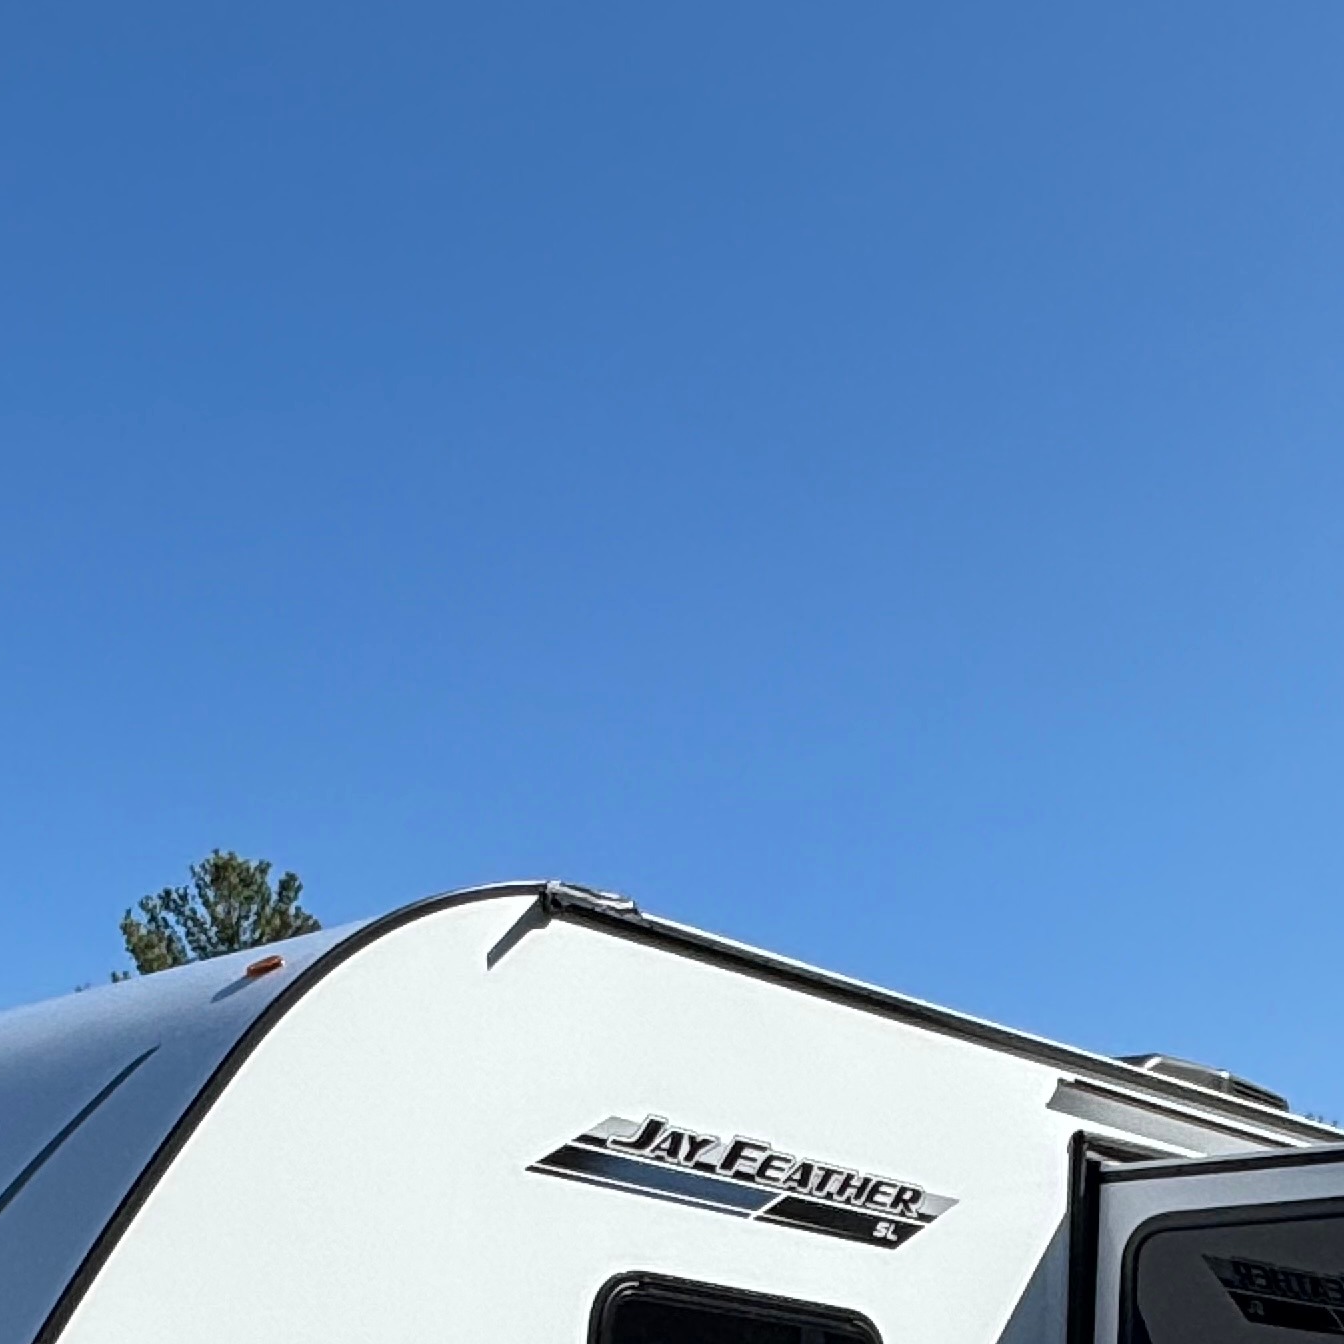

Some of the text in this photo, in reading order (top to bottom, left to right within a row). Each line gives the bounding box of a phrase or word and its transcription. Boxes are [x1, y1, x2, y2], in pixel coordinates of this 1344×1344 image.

[609, 1114, 924, 1217] JAY FEATHER
[872, 1221, 898, 1242] SL
